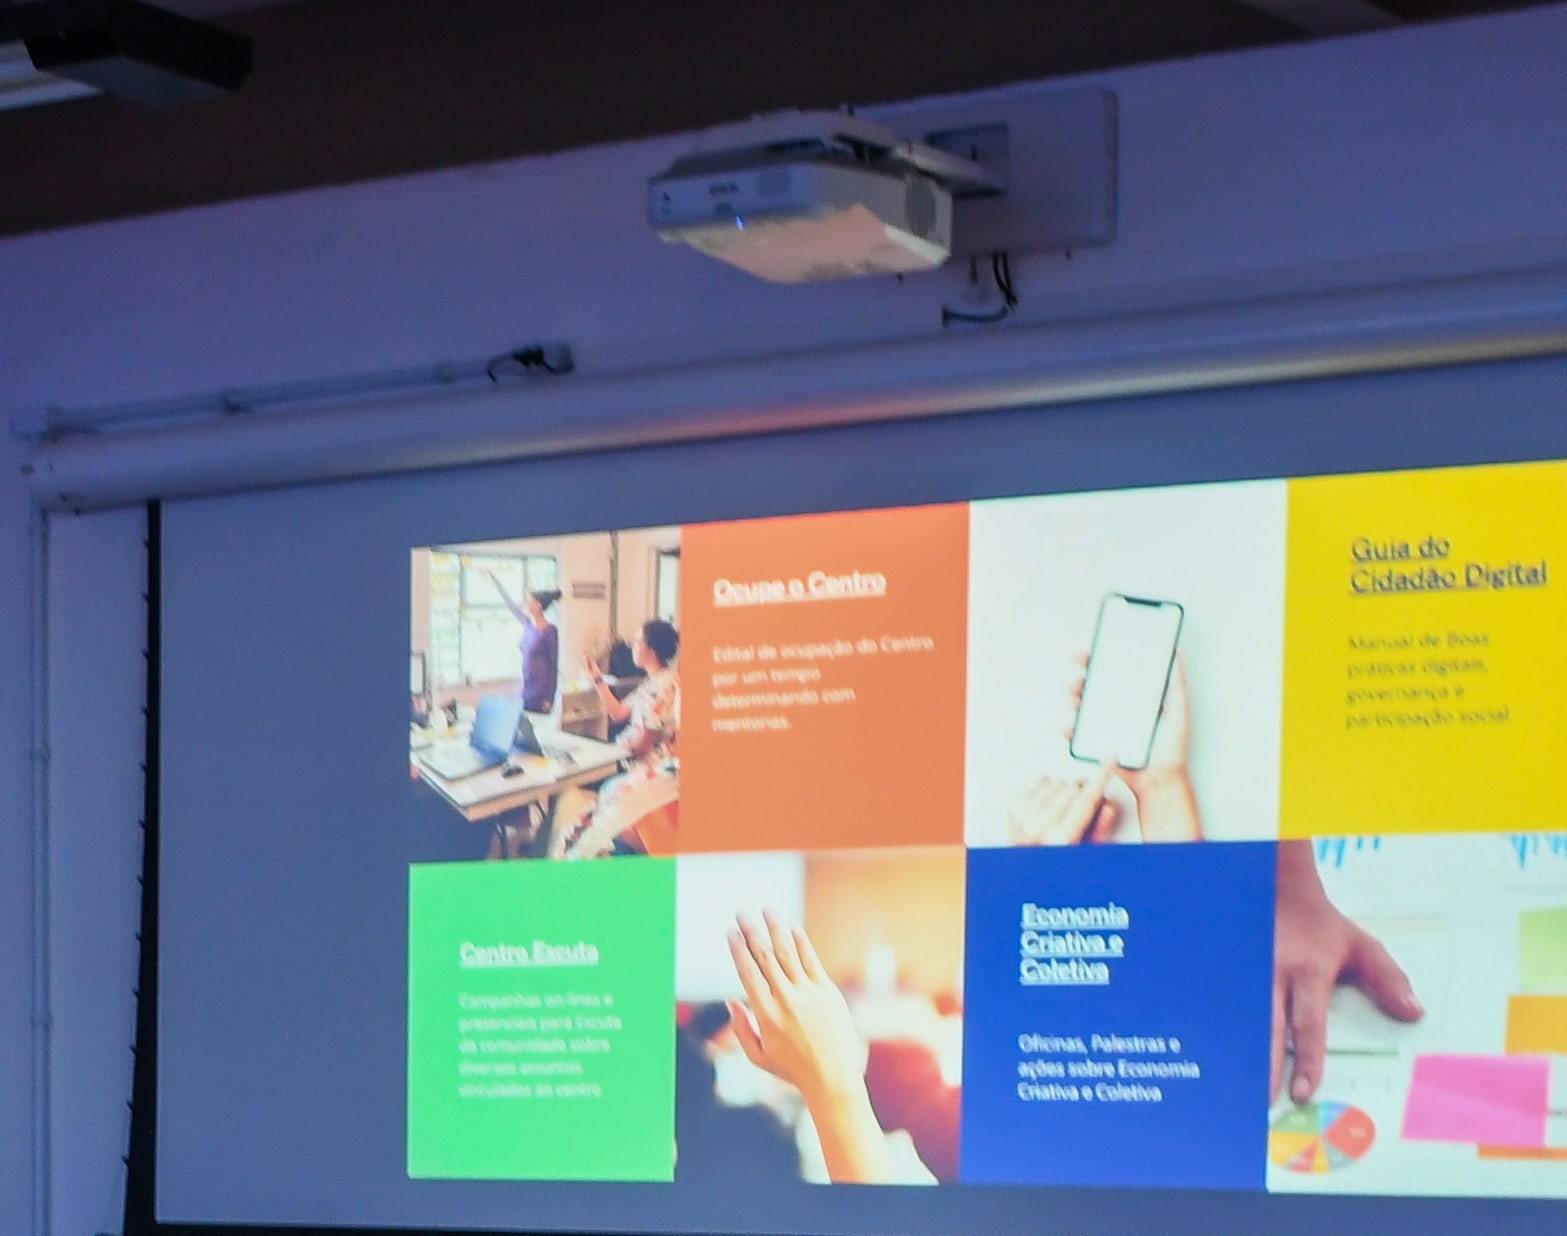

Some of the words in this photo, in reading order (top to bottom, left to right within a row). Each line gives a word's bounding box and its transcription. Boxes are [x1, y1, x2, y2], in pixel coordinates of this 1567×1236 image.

[1350, 536, 1410, 563] Guia
[1417, 534, 1451, 560] do
[713, 577, 786, 606] Ocupe
[787, 577, 805, 602] o
[807, 569, 887, 600] Centro
[1350, 566, 1457, 595] Cidadão
[1463, 560, 1548, 590] Digital
[757, 642, 778, 661] de
[855, 636, 878, 655] do
[879, 634, 934, 653] Centro
[821, 687, 856, 704] com
[1021, 902, 1130, 931] Economia
[460, 941, 530, 969] Centro
[532, 939, 600, 967] Escuta
[1020, 930, 1106, 958] Criativa
[1107, 934, 1125, 957] e
[1020, 957, 1110, 985] Coletiva
[1090, 1032, 1168, 1054] Palestras
[1168, 1036, 1182, 1054] e
[1017, 1058, 1067, 1080] ações
[1067, 1058, 1116, 1079] sobre
[1117, 1058, 1202, 1079] Economia
[1016, 1080, 1080, 1102] Criativa
[1081, 1084, 1094, 1102] e
[1094, 1081, 1164, 1103] Coletiva
